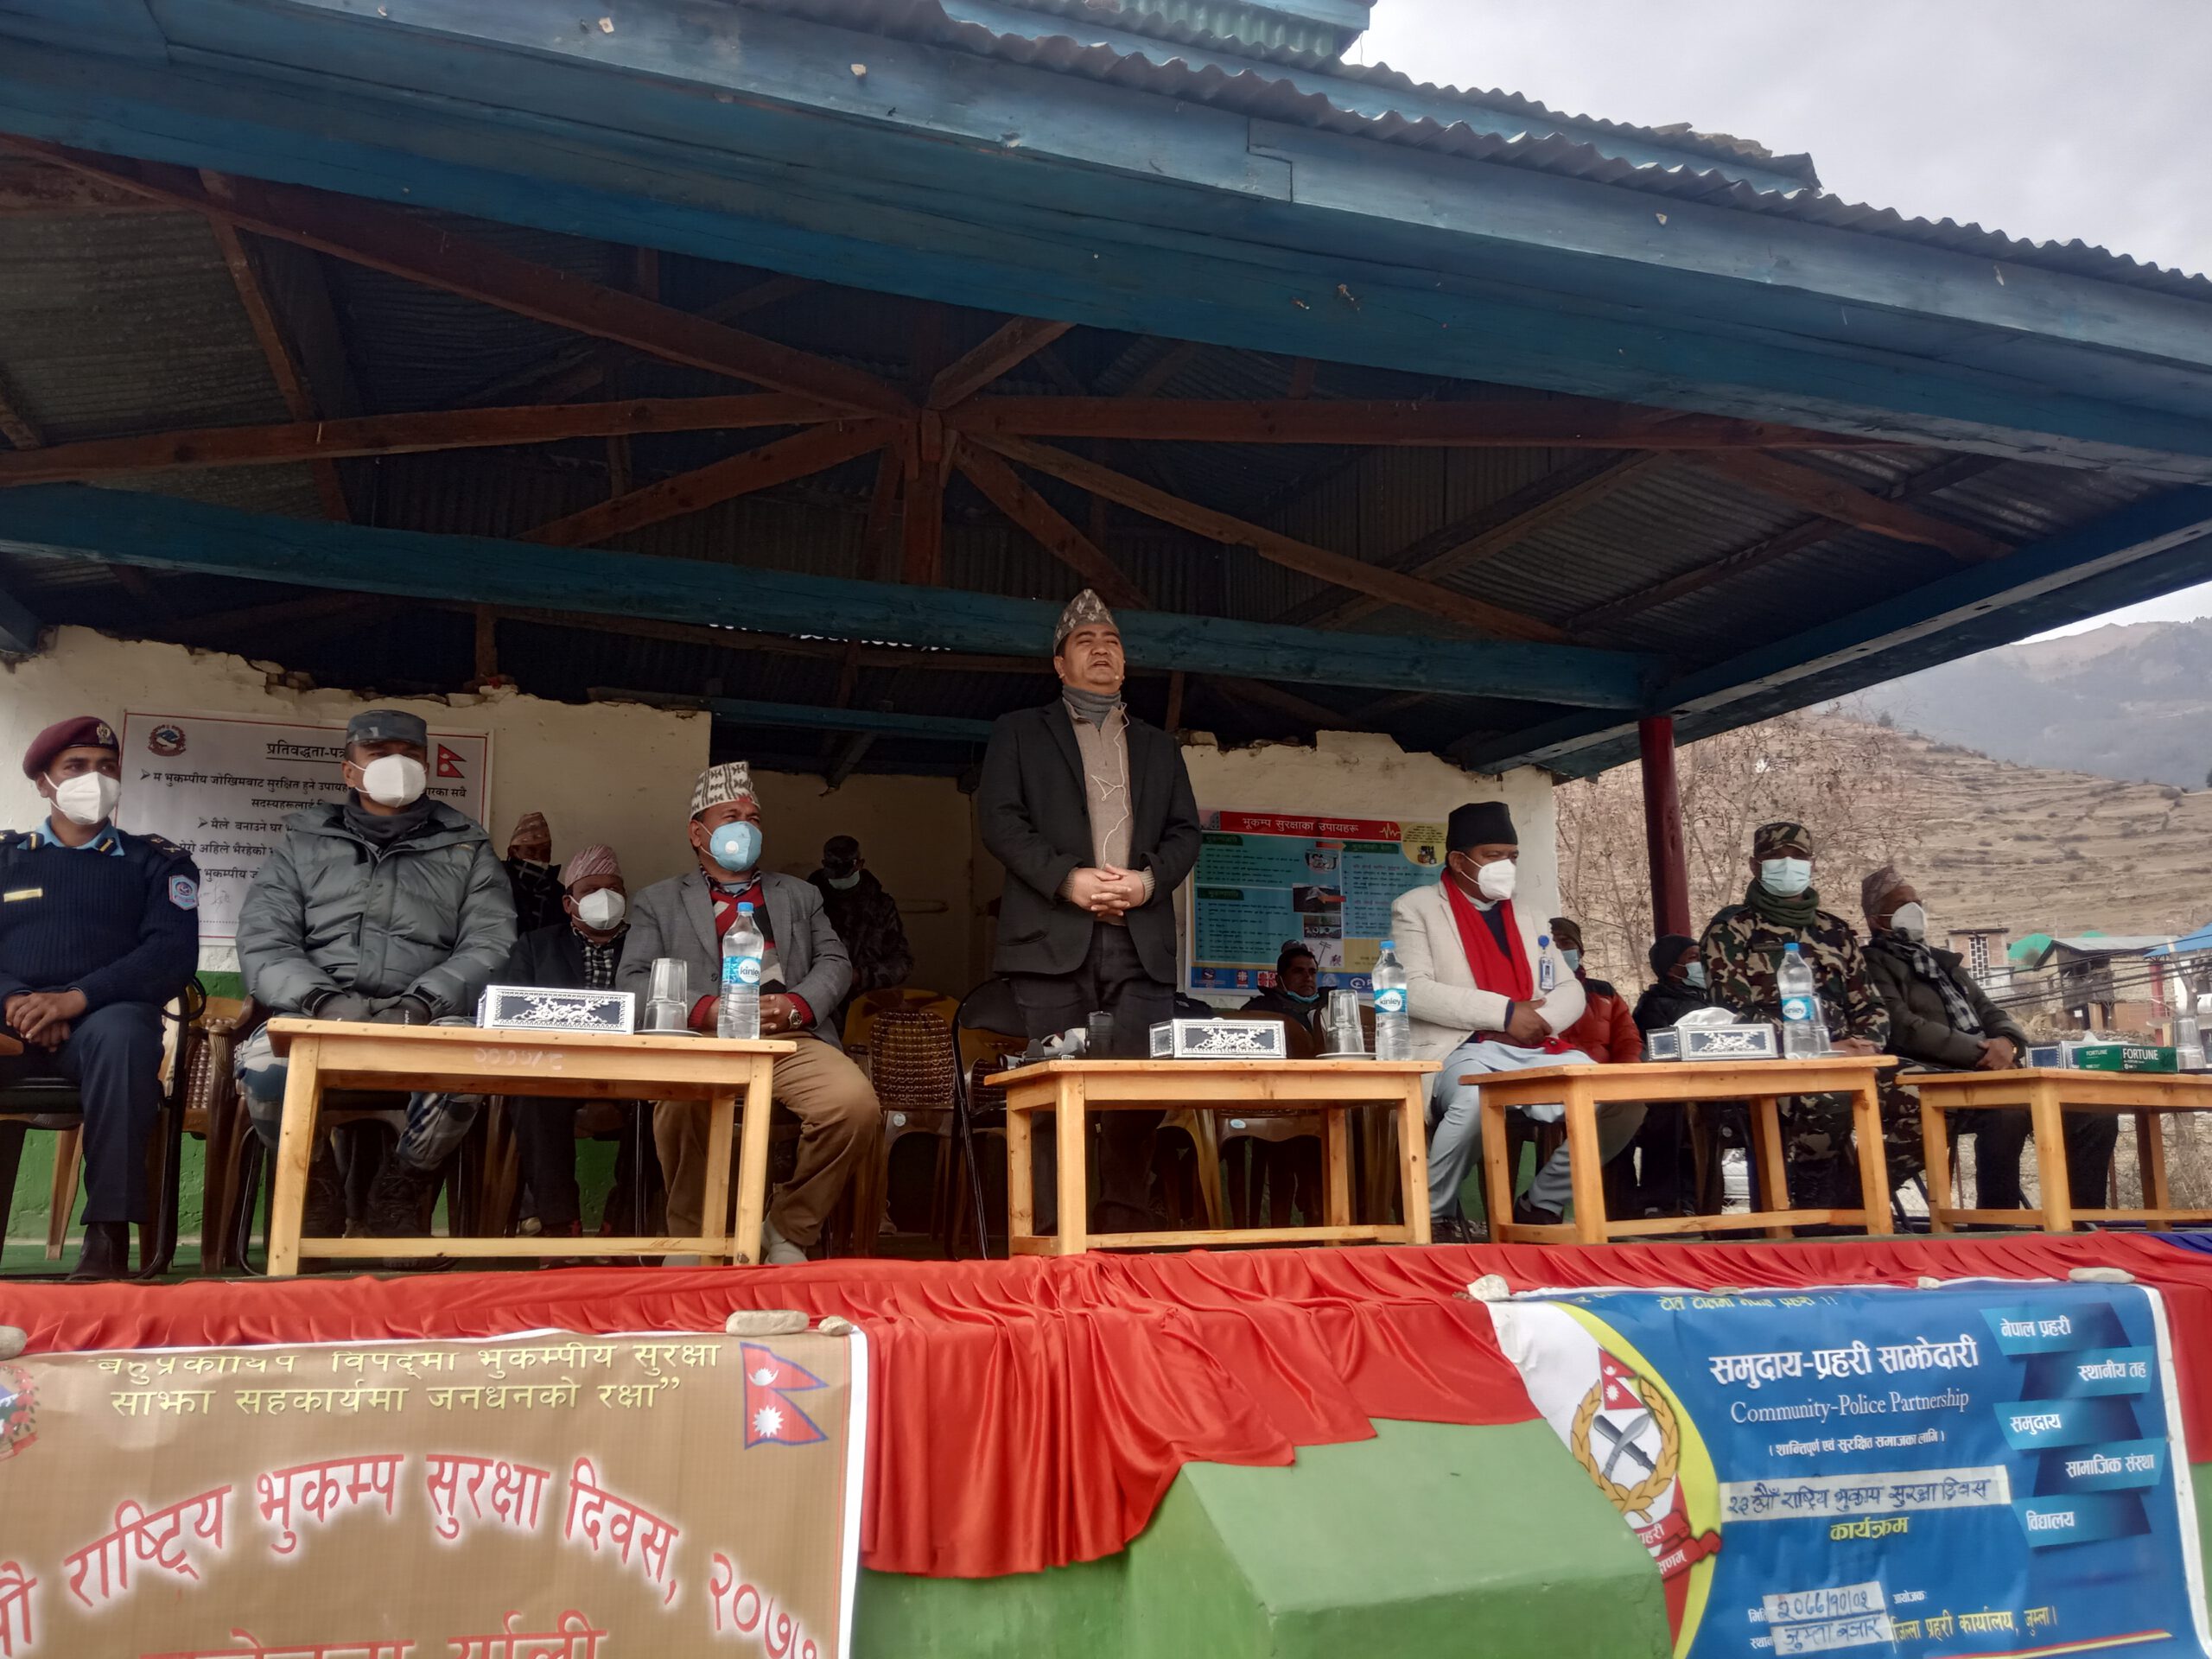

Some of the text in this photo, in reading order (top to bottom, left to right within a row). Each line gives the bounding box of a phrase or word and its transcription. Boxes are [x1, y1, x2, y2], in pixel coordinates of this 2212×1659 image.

[2122, 1048, 2158, 1059] FORTUNE
[2000, 1315, 2071, 1338] नेपाल प्रहरी
[478, 1341, 619, 1379] भुकम्पीय
[633, 1343, 722, 1378] सुरक्षा
[2077, 1359, 2147, 1382] स्थानीय तह
[235, 1380, 410, 1414] सहकार्यमा
[427, 1376, 581, 1411] जनधनको
[1731, 1388, 1969, 1424] Community-Police Partnership
[2010, 1413, 2062, 1435] समुदाय
[2065, 1452, 2155, 1479] सामाजिक संस्था
[257, 1454, 404, 1554] भुकम्प
[426, 1454, 550, 1539] सुरक्षा
[1830, 1516, 1910, 1541] कार्यक्रम
[2026, 1510, 2075, 1532] विद्यालय
[1924, 1609, 1955, 1642] प्रहरी
